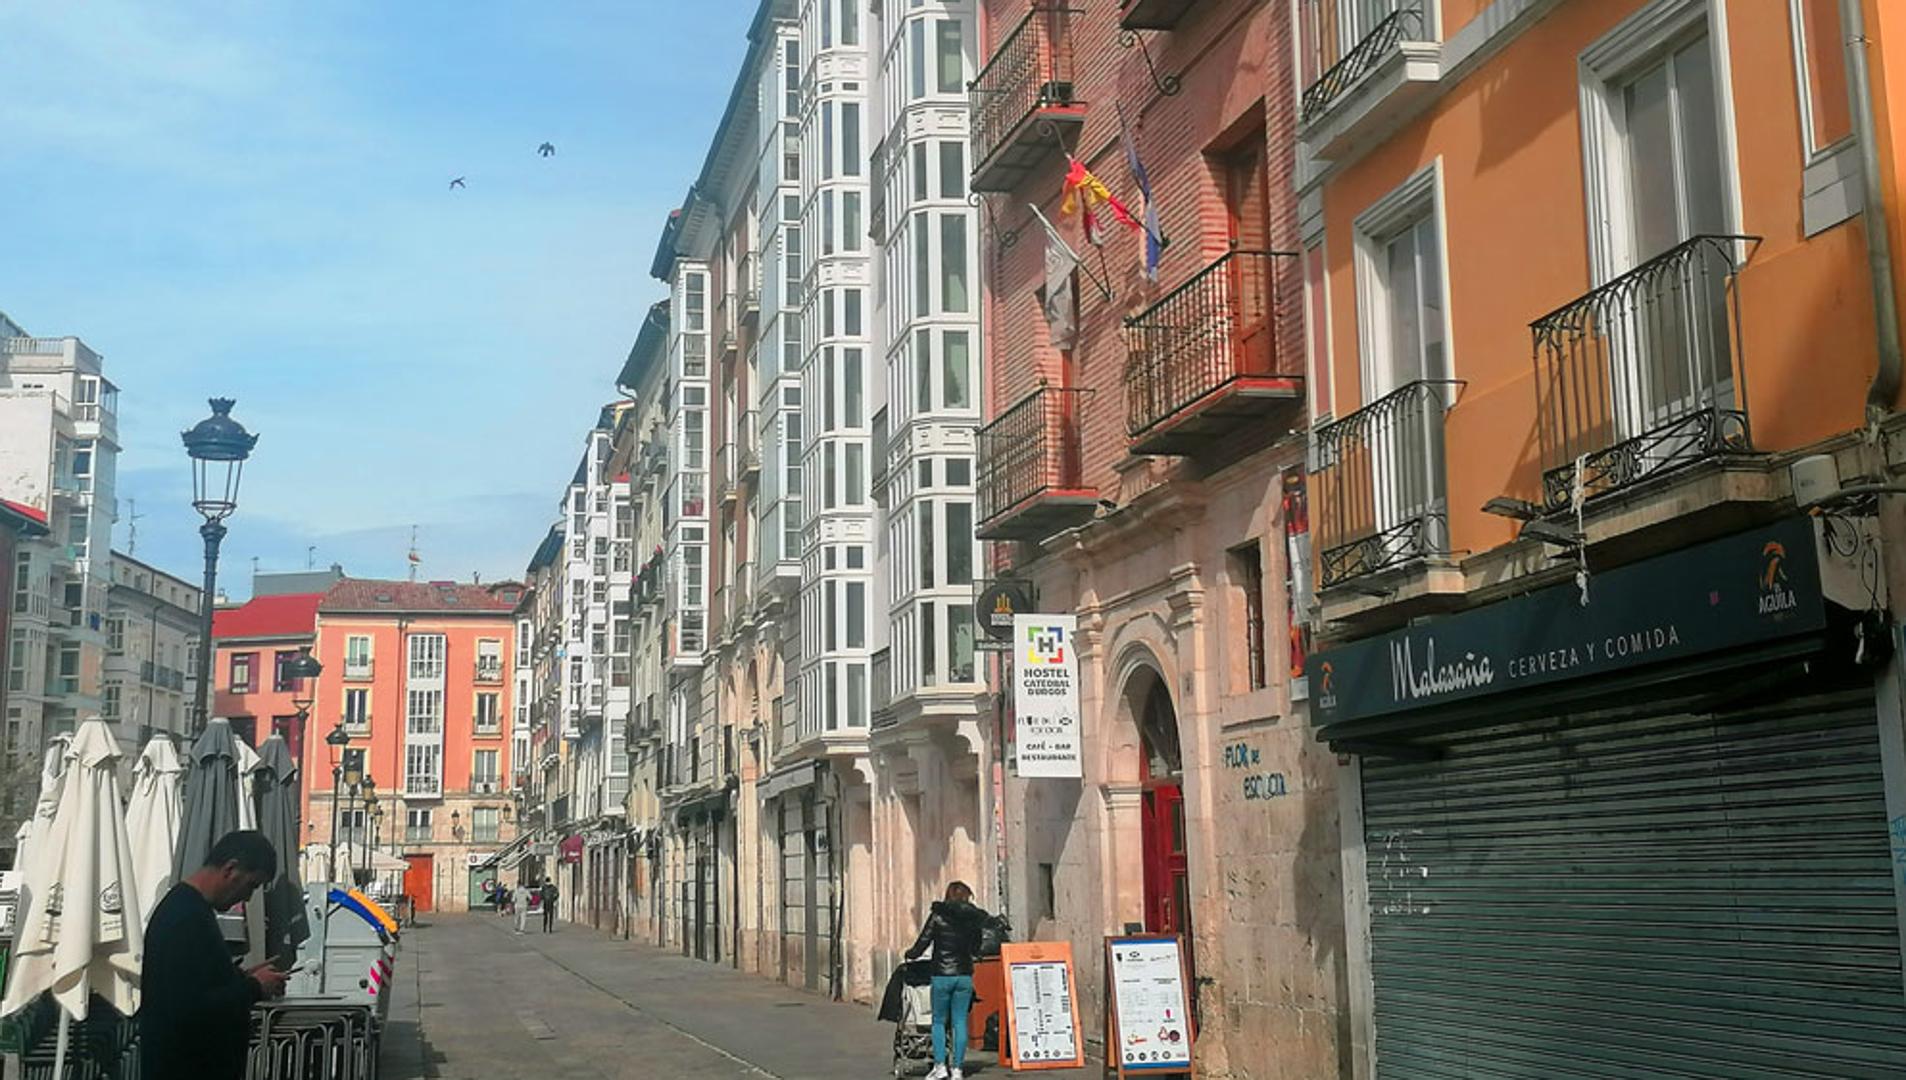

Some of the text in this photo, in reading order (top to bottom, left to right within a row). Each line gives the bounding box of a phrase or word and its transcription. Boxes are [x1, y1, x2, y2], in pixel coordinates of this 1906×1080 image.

[1038, 637, 1054, 652] H
[1390, 626, 1681, 702] Malasaña CERVEZA Y COMIDA
[1023, 668, 1070, 678] HOSTEL
[1023, 680, 1071, 688] CATEDRAL
